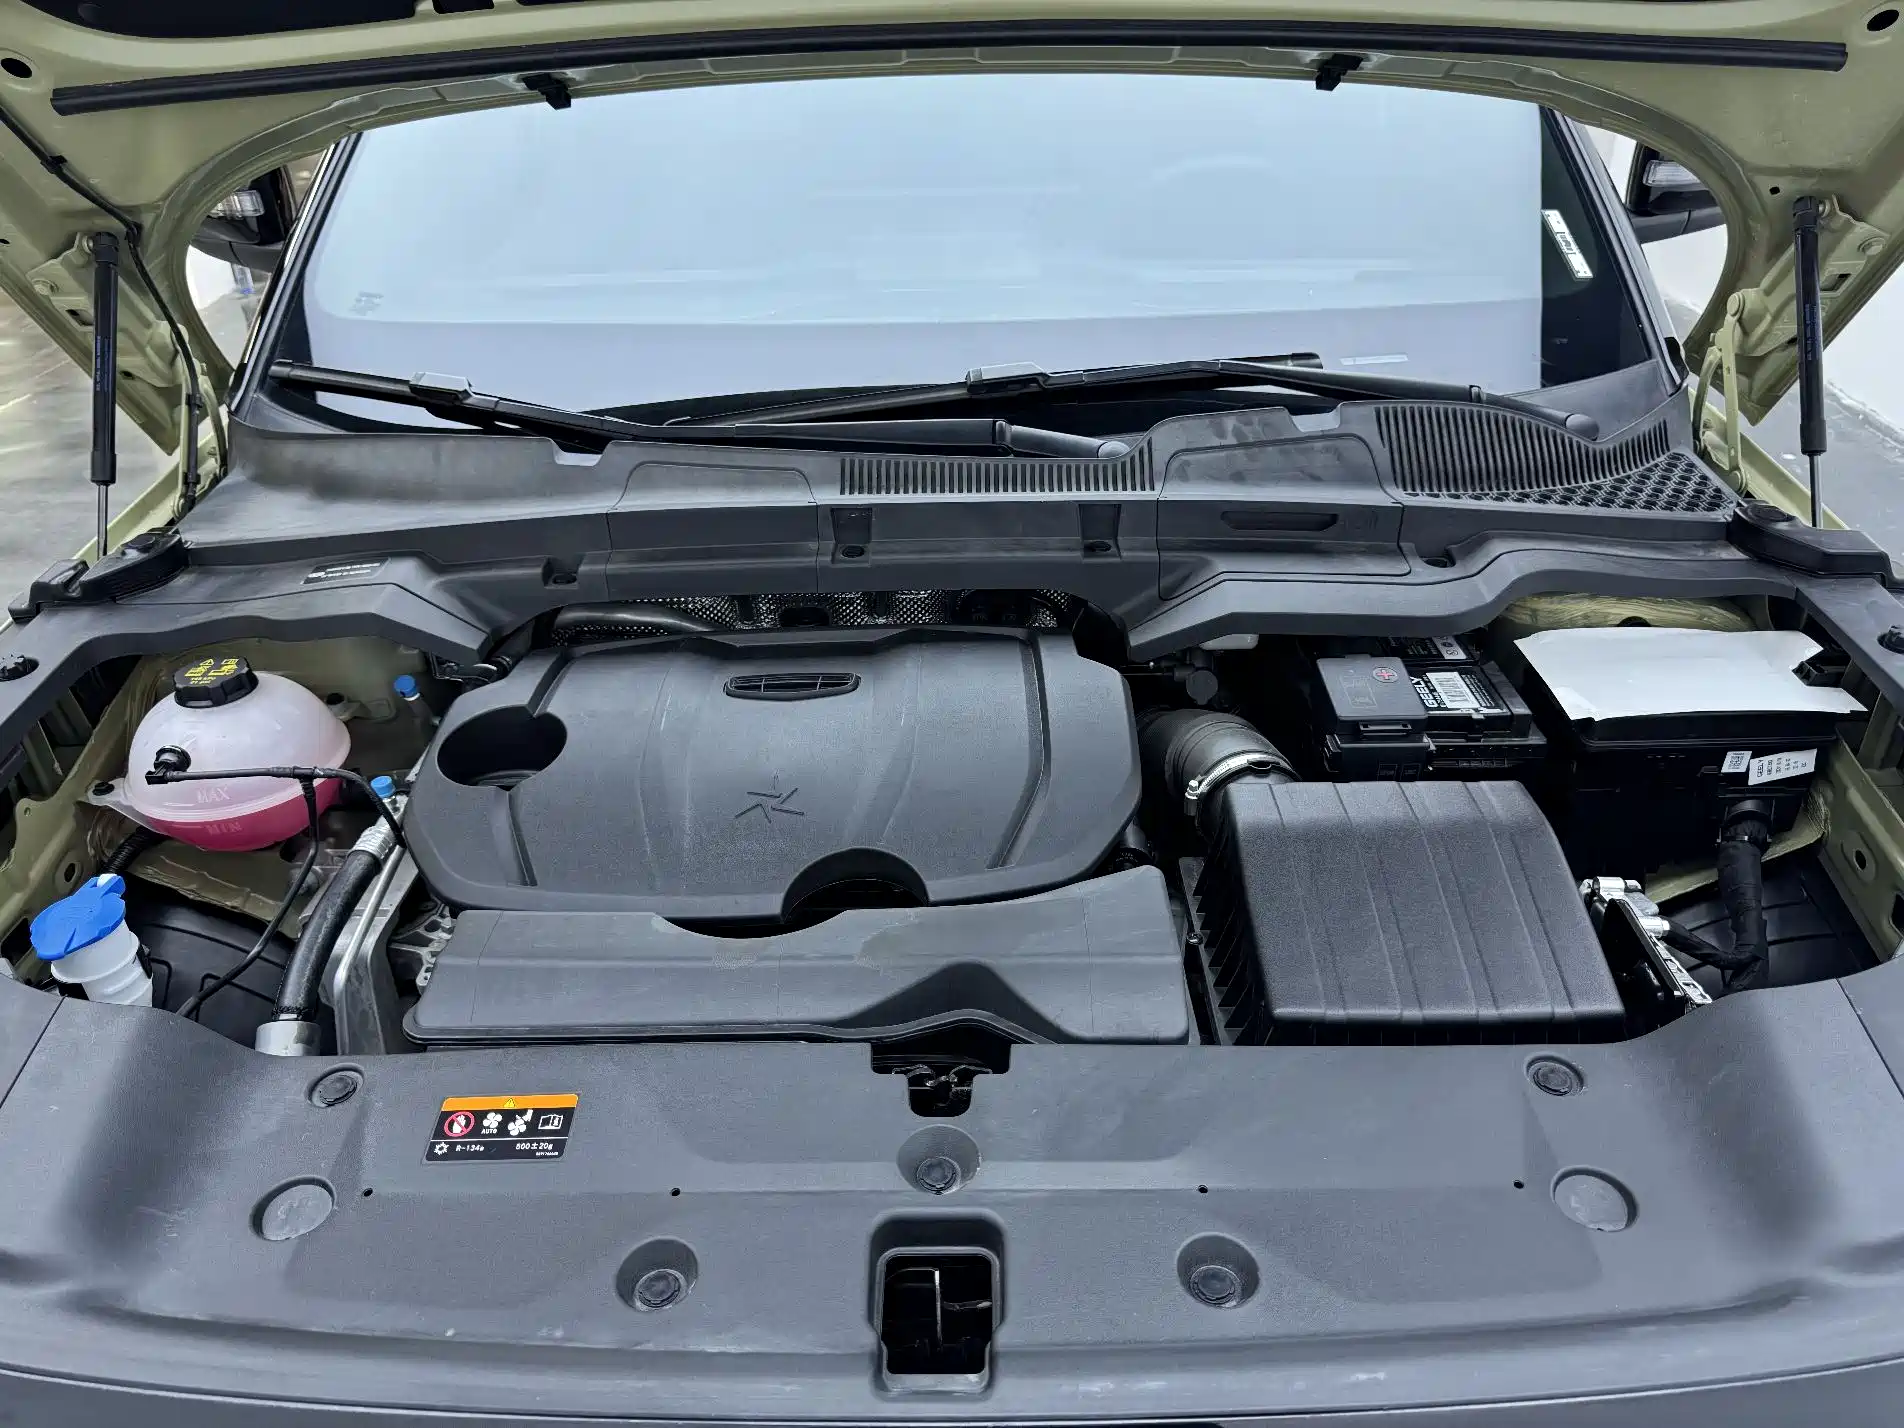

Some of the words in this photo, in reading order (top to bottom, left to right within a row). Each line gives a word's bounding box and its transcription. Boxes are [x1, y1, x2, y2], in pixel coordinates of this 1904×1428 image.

[1410, 676, 1439, 708] GEELY
[197, 785, 231, 803] MAX
[205, 821, 242, 836] MIN
